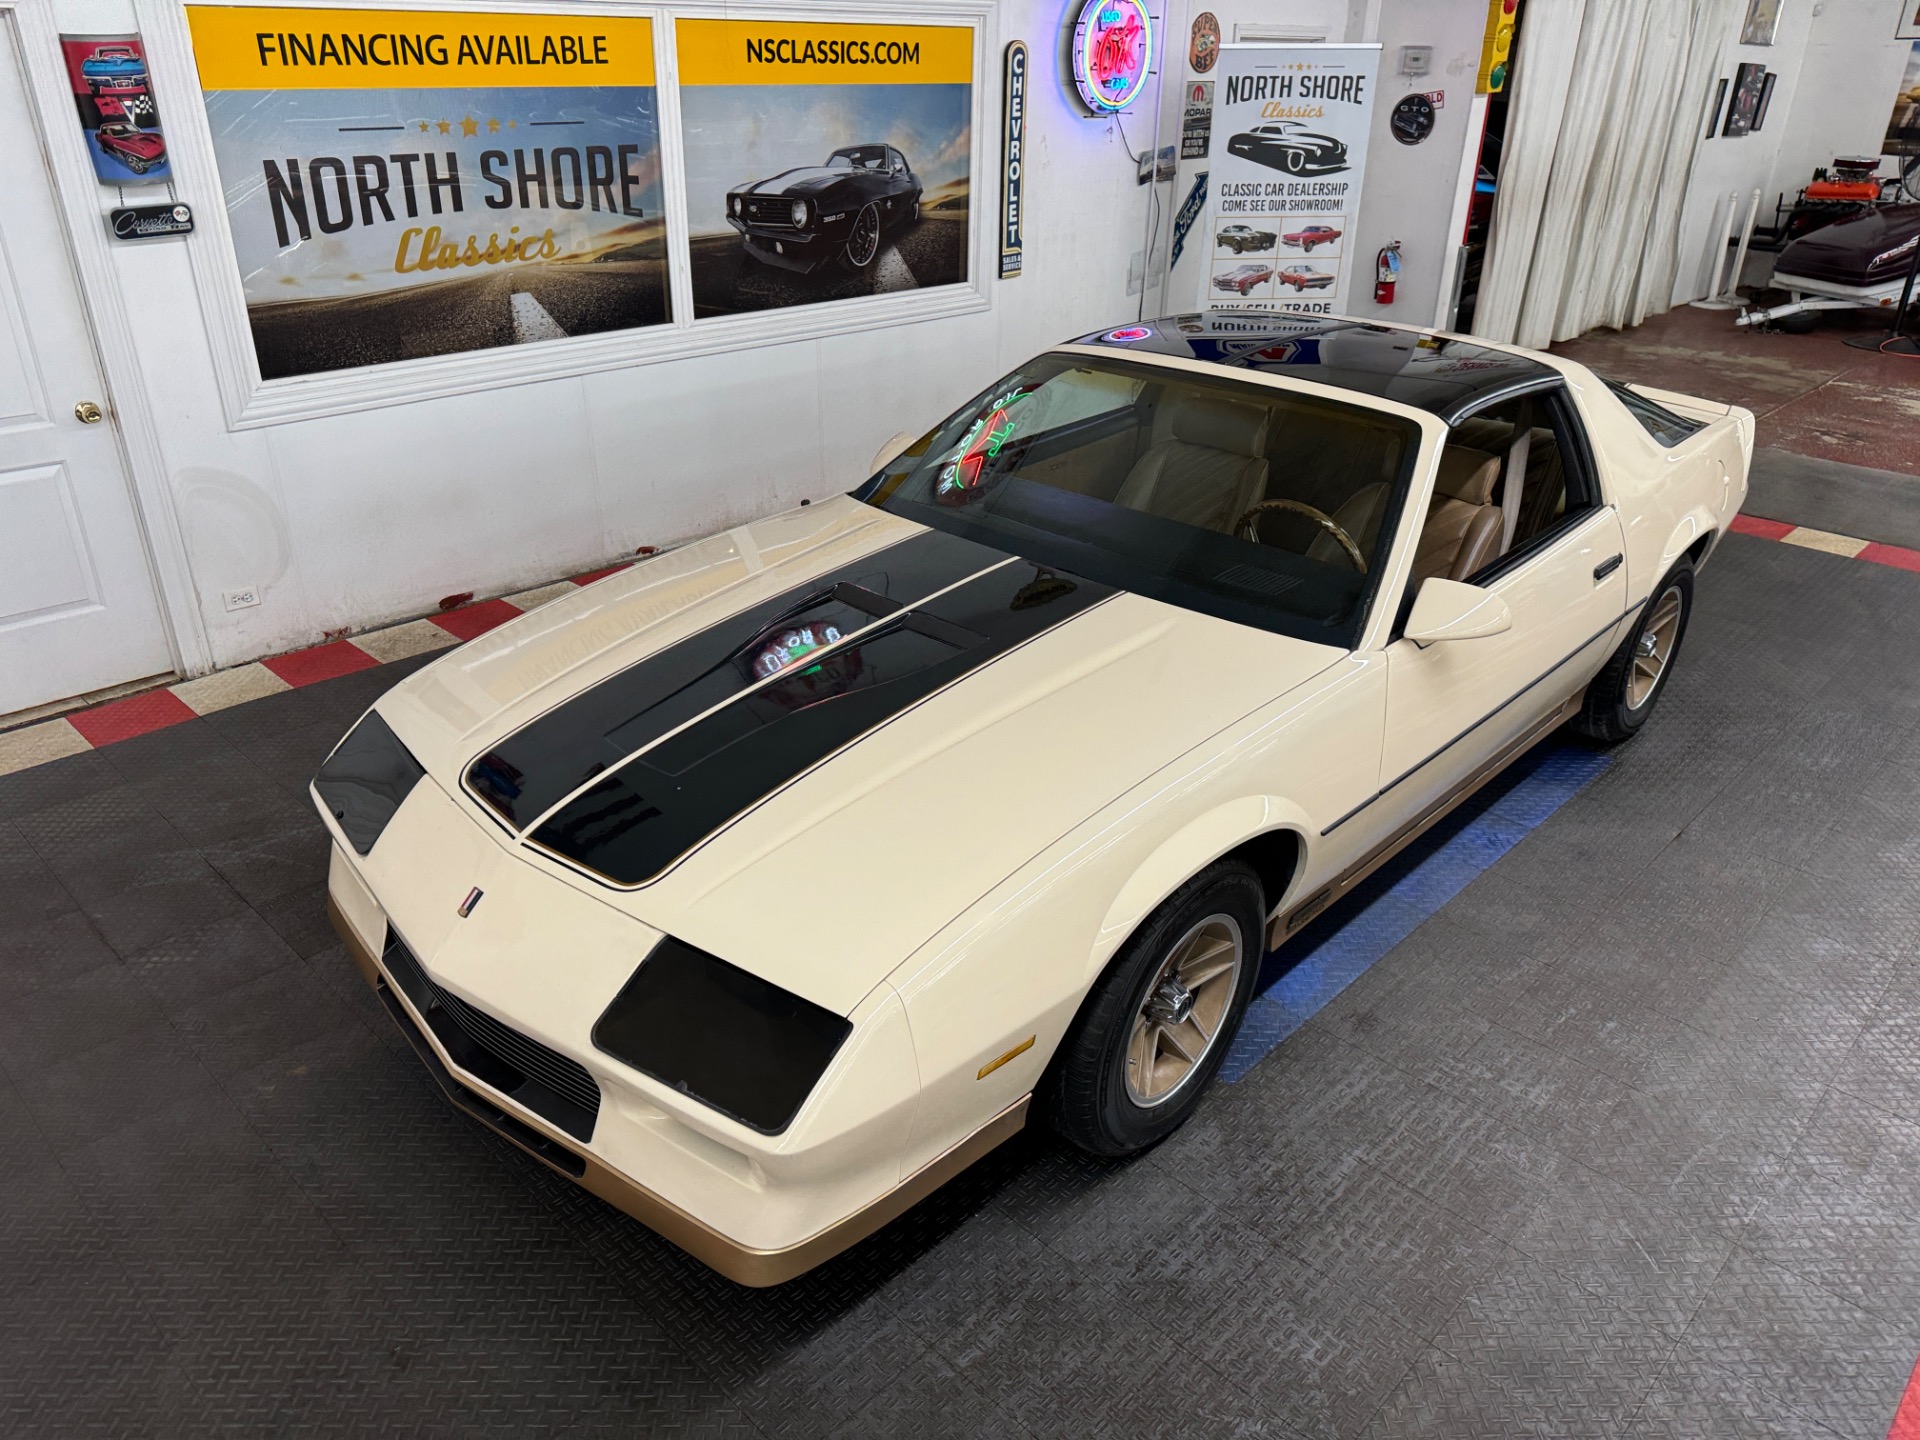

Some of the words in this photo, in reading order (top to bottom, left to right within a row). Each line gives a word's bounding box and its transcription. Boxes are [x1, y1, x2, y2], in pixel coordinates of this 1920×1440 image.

[256, 33, 449, 66] FINANCING
[457, 34, 609, 65] AVAILABLE
[746, 38, 920, 65] NSCLASSICS.COM
[1195, 49, 1215, 69] BEE
[1226, 75, 1293, 106] NORTH
[1299, 75, 1366, 105] SHORE
[1425, 92, 1443, 104] OLD
[1184, 107, 1212, 117] MOPAR
[1261, 101, 1325, 119] Classics
[1400, 105, 1430, 113] GTO
[1008, 53, 1024, 244] CHEVROLET
[263, 151, 464, 248] NORTH
[480, 144, 643, 218] SHORE
[1221, 183, 1262, 197] CLASSIC
[1265, 183, 1285, 196] CAR
[1287, 183, 1349, 196] DEALERSHIP
[1180, 192, 1202, 234] Ford
[1222, 200, 1248, 212] COME
[1249, 200, 1266, 211] SEE
[1268, 200, 1287, 211] OUR
[1288, 199, 1344, 211] SHOWROOM!
[114, 211, 176, 235] Corvette
[394, 226, 562, 274] Classics
